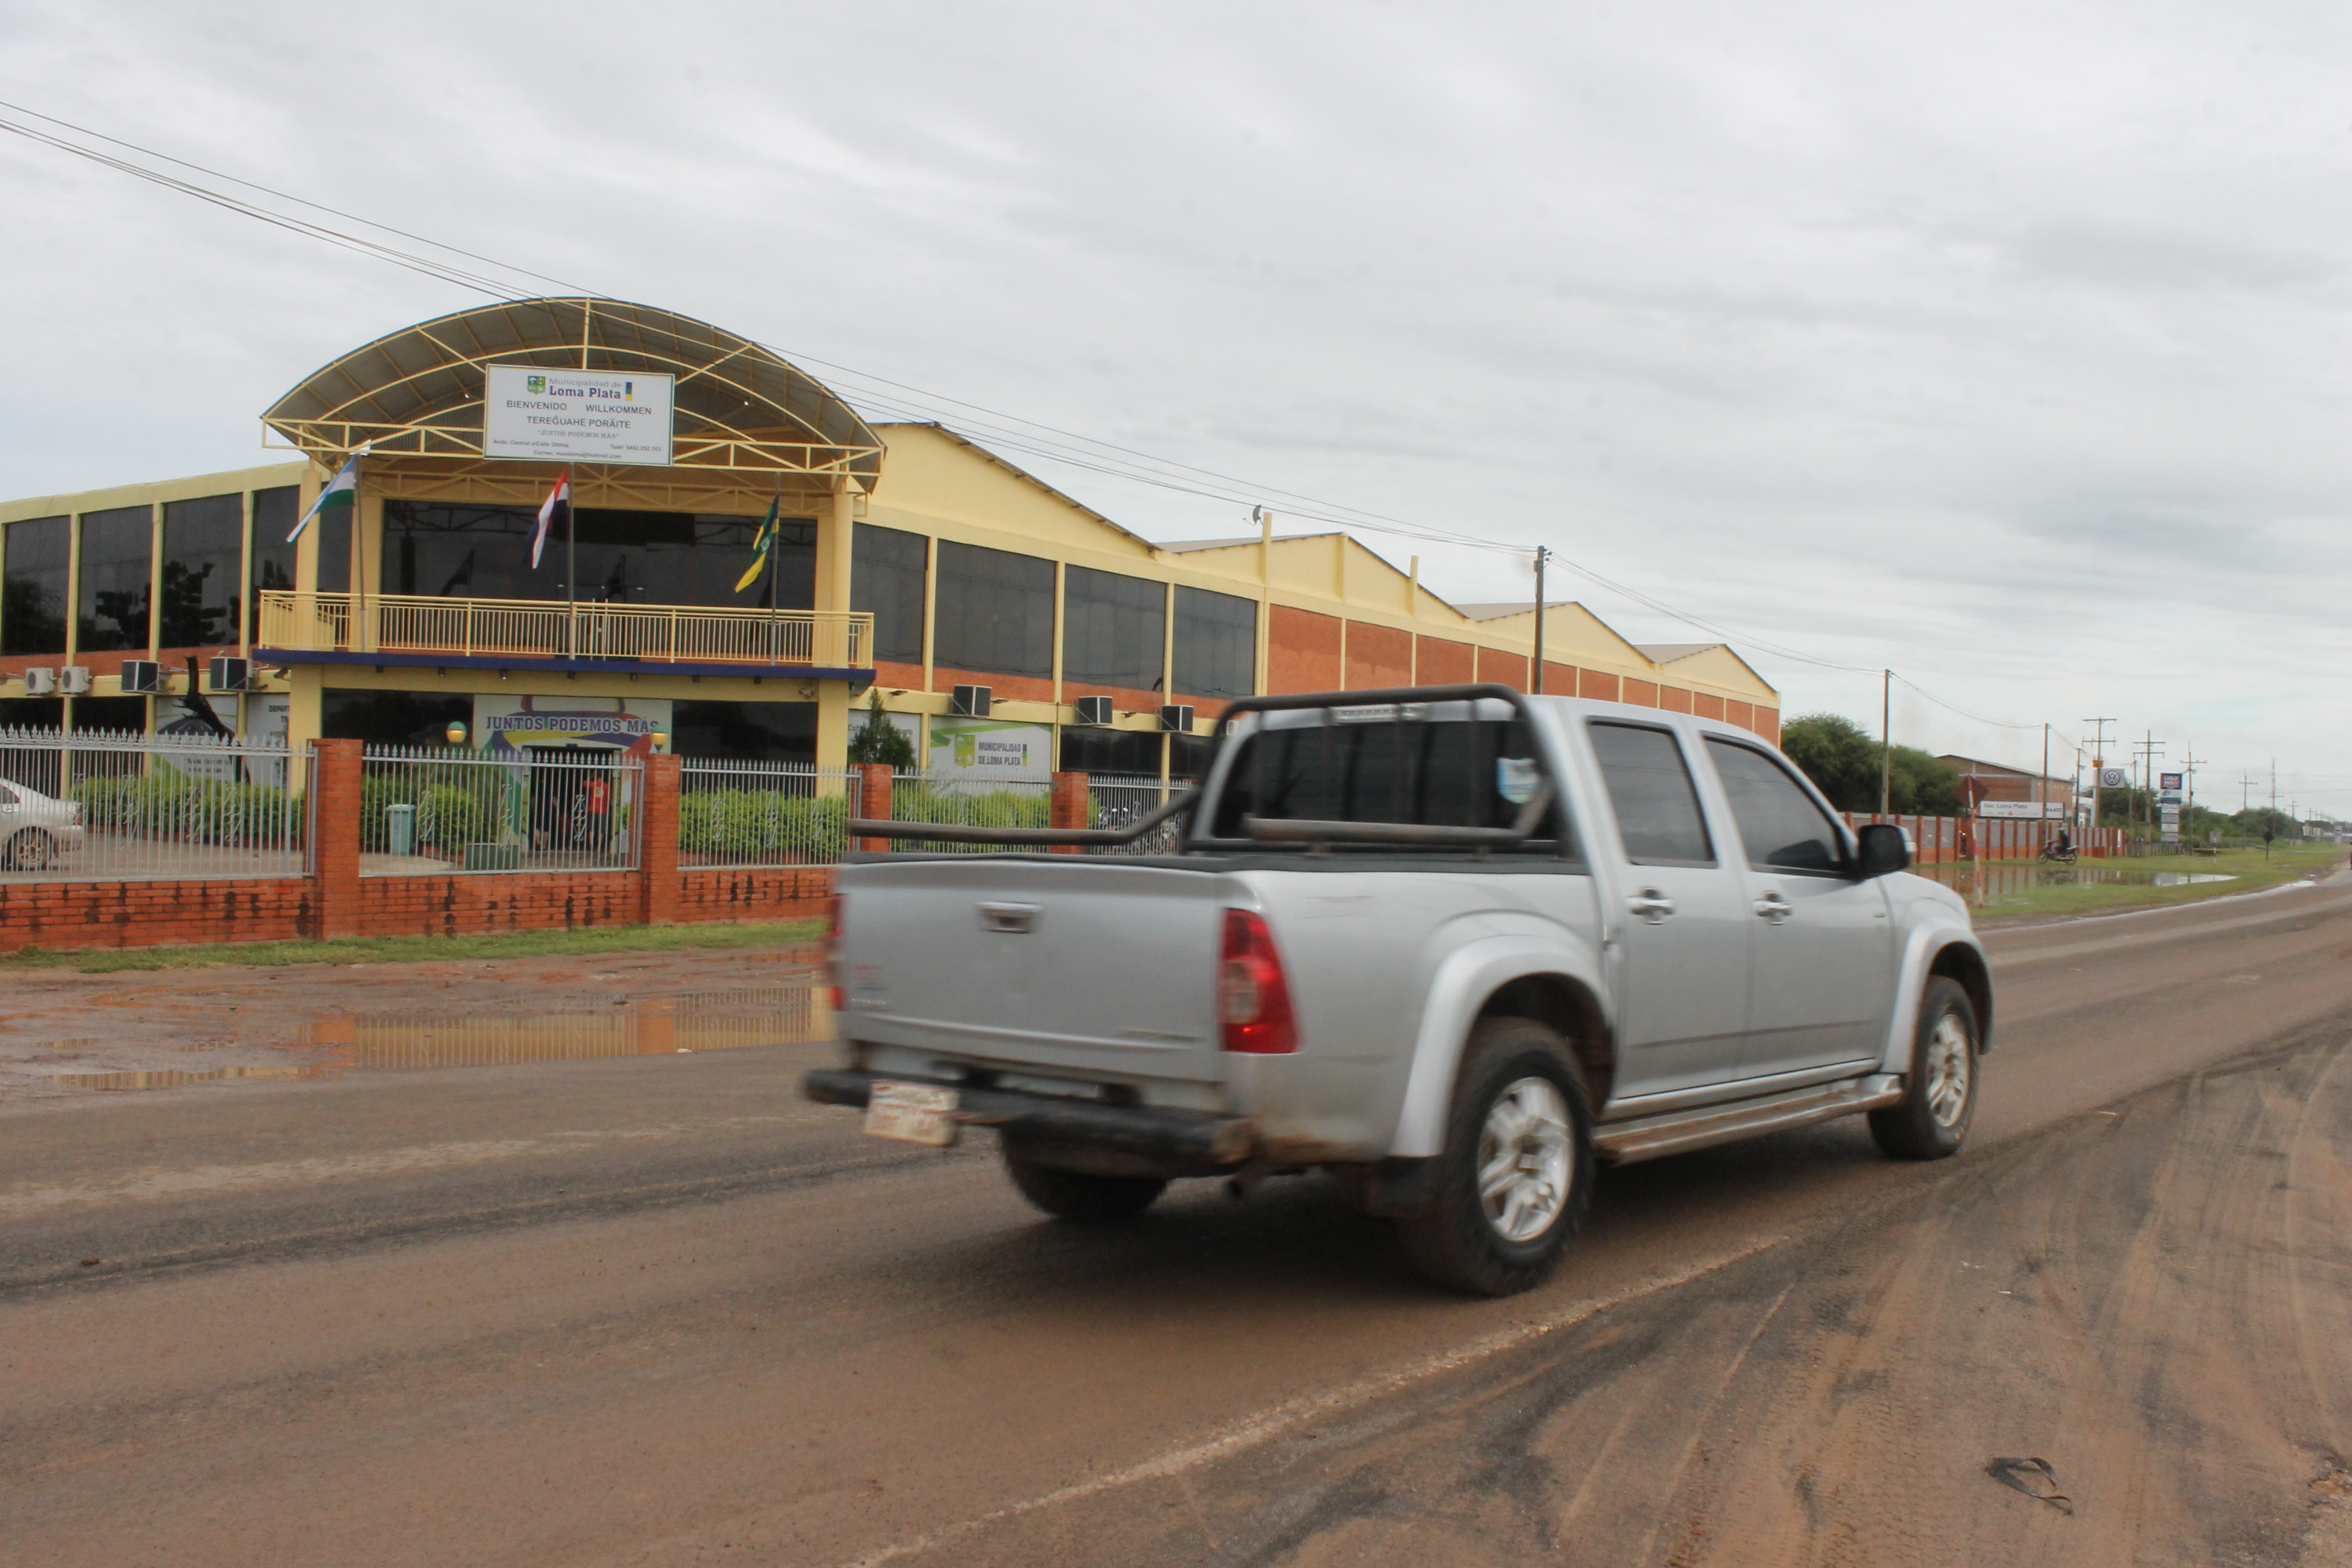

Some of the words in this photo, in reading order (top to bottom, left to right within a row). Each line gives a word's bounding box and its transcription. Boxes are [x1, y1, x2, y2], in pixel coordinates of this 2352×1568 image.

[549, 378, 609, 387] Municipalidad
[549, 386, 584, 397] Loma
[589, 388, 621, 399] Plata
[507, 400, 567, 410] BIENVENIDO
[586, 404, 652, 415] WILLKOMMEN
[486, 716, 543, 731] JUNTOS
[549, 717, 621, 732] PODEMOS
[978, 742, 1021, 752] MUNICIPALIDAD
[987, 756, 1003, 765] LOMA
[1004, 757, 1021, 766] PLATA
